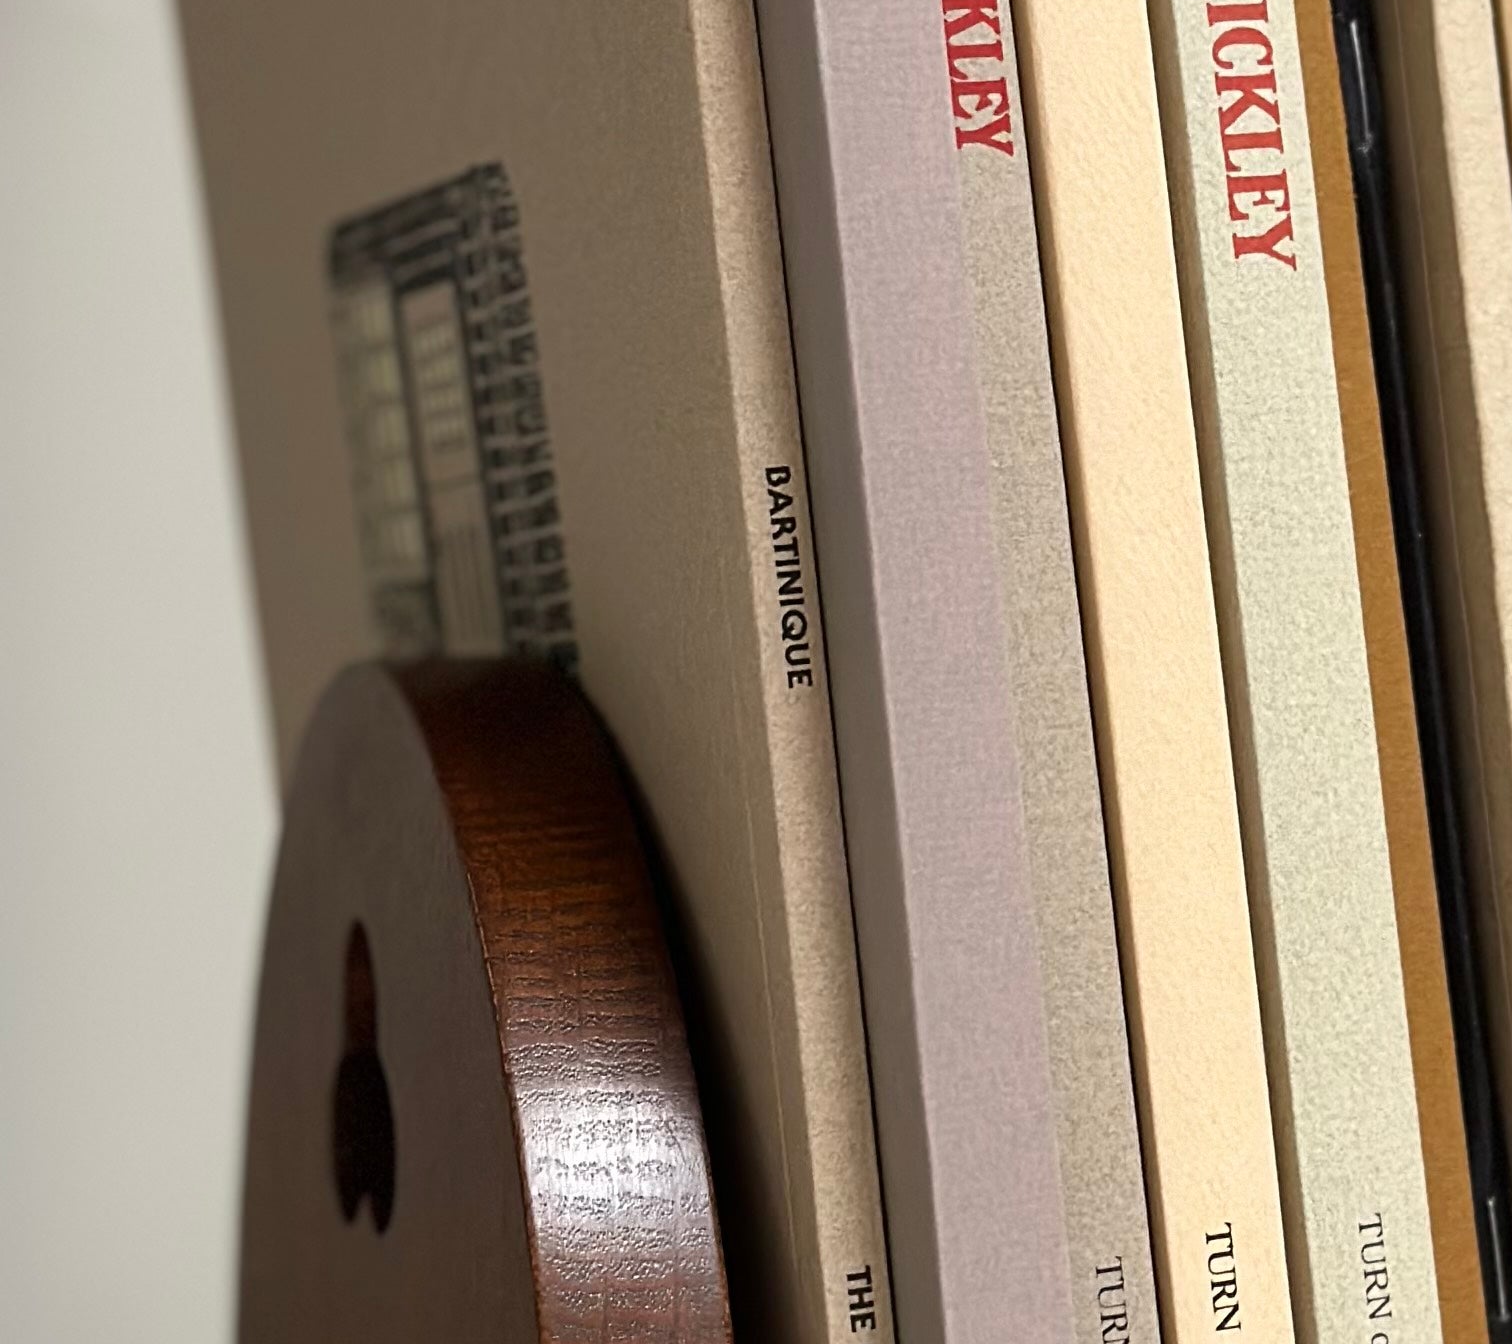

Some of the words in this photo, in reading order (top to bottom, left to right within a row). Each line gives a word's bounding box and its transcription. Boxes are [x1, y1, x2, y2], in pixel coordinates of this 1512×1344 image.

[765, 466, 813, 688] BARTINIQUE
[846, 1265, 876, 1332] THE
[1205, 1223, 1242, 1333] TURN
[1359, 1213, 1392, 1320] TURN
